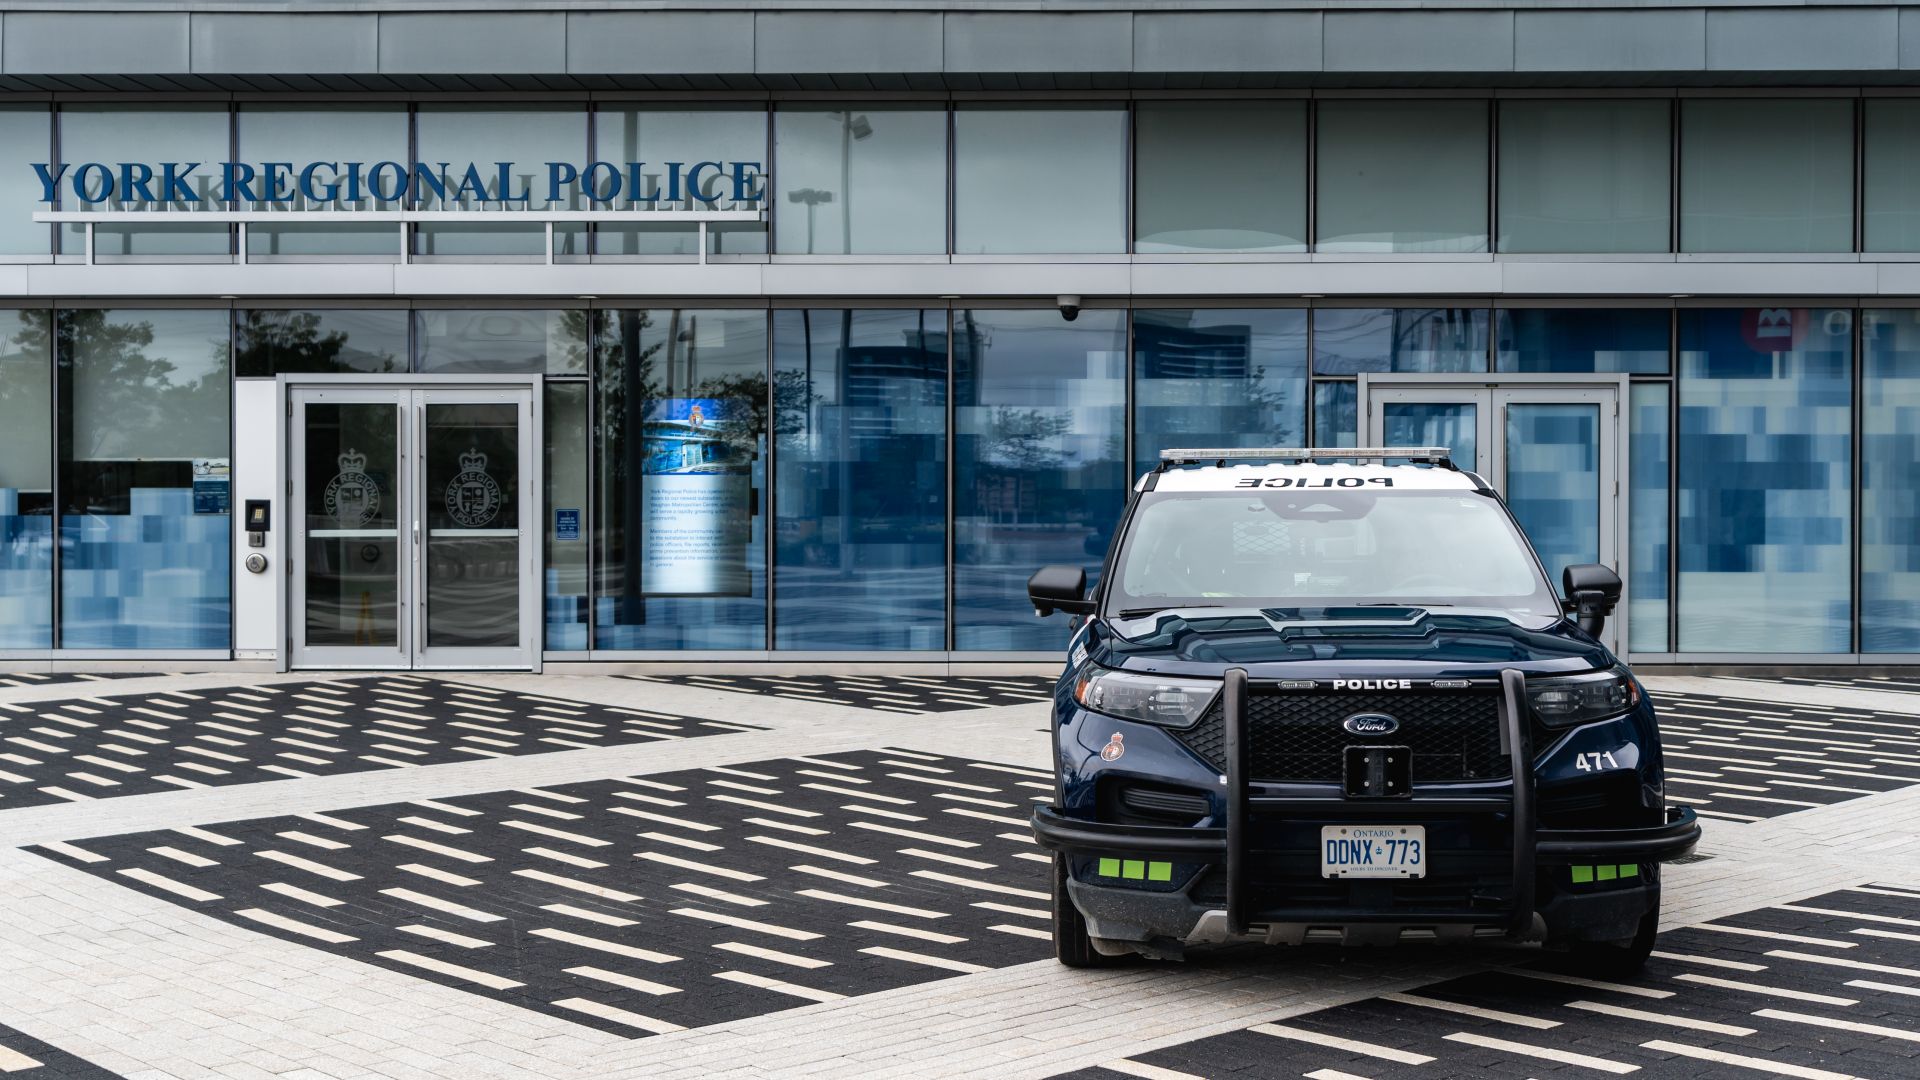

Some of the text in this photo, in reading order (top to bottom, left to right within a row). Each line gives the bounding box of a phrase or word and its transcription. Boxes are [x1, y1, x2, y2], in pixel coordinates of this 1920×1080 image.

[30, 161, 765, 203] YORK REGIONAL POLICE
[326, 472, 378, 513] YORK REGIONAL
[447, 472, 500, 525] YORK REGIONAL POLICE
[1333, 679, 1411, 690] POLICE
[1357, 718, 1386, 731] Ford
[1576, 751, 1618, 771] 471
[1353, 829, 1394, 838] ONTARIO
[1327, 839, 1420, 864] DDNX 773
